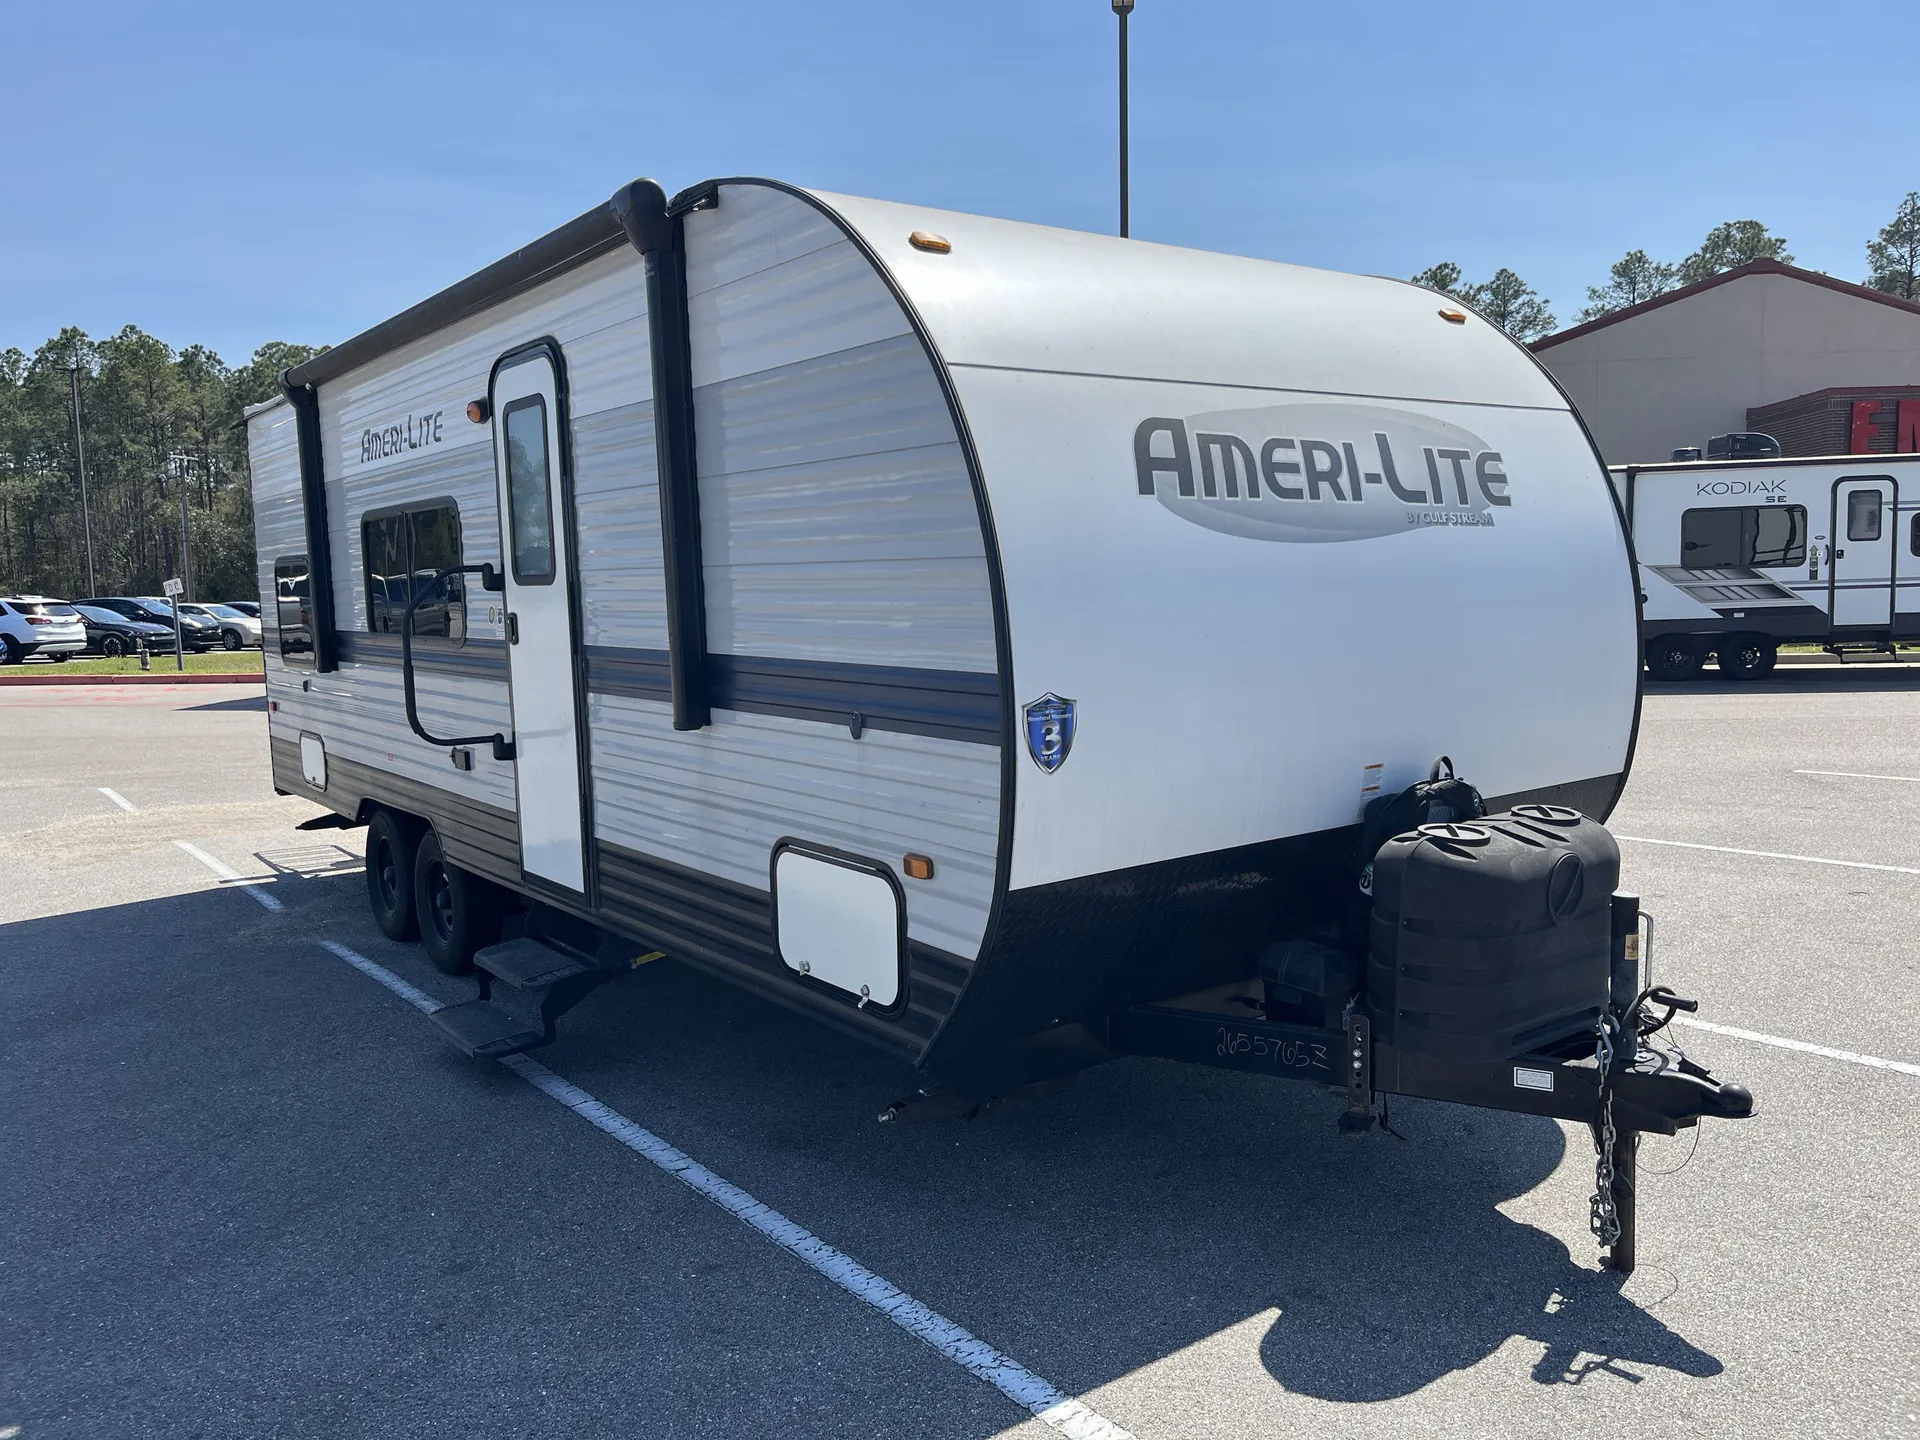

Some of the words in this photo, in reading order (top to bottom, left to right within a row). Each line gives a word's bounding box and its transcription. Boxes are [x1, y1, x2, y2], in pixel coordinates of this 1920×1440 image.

[1133, 416, 1513, 508] AMERI-LITE
[1697, 479, 1787, 496] KODIAK
[1421, 511, 1448, 524] GULF
[1449, 511, 1495, 526] STREAM
[1041, 721, 1061, 754] 3
